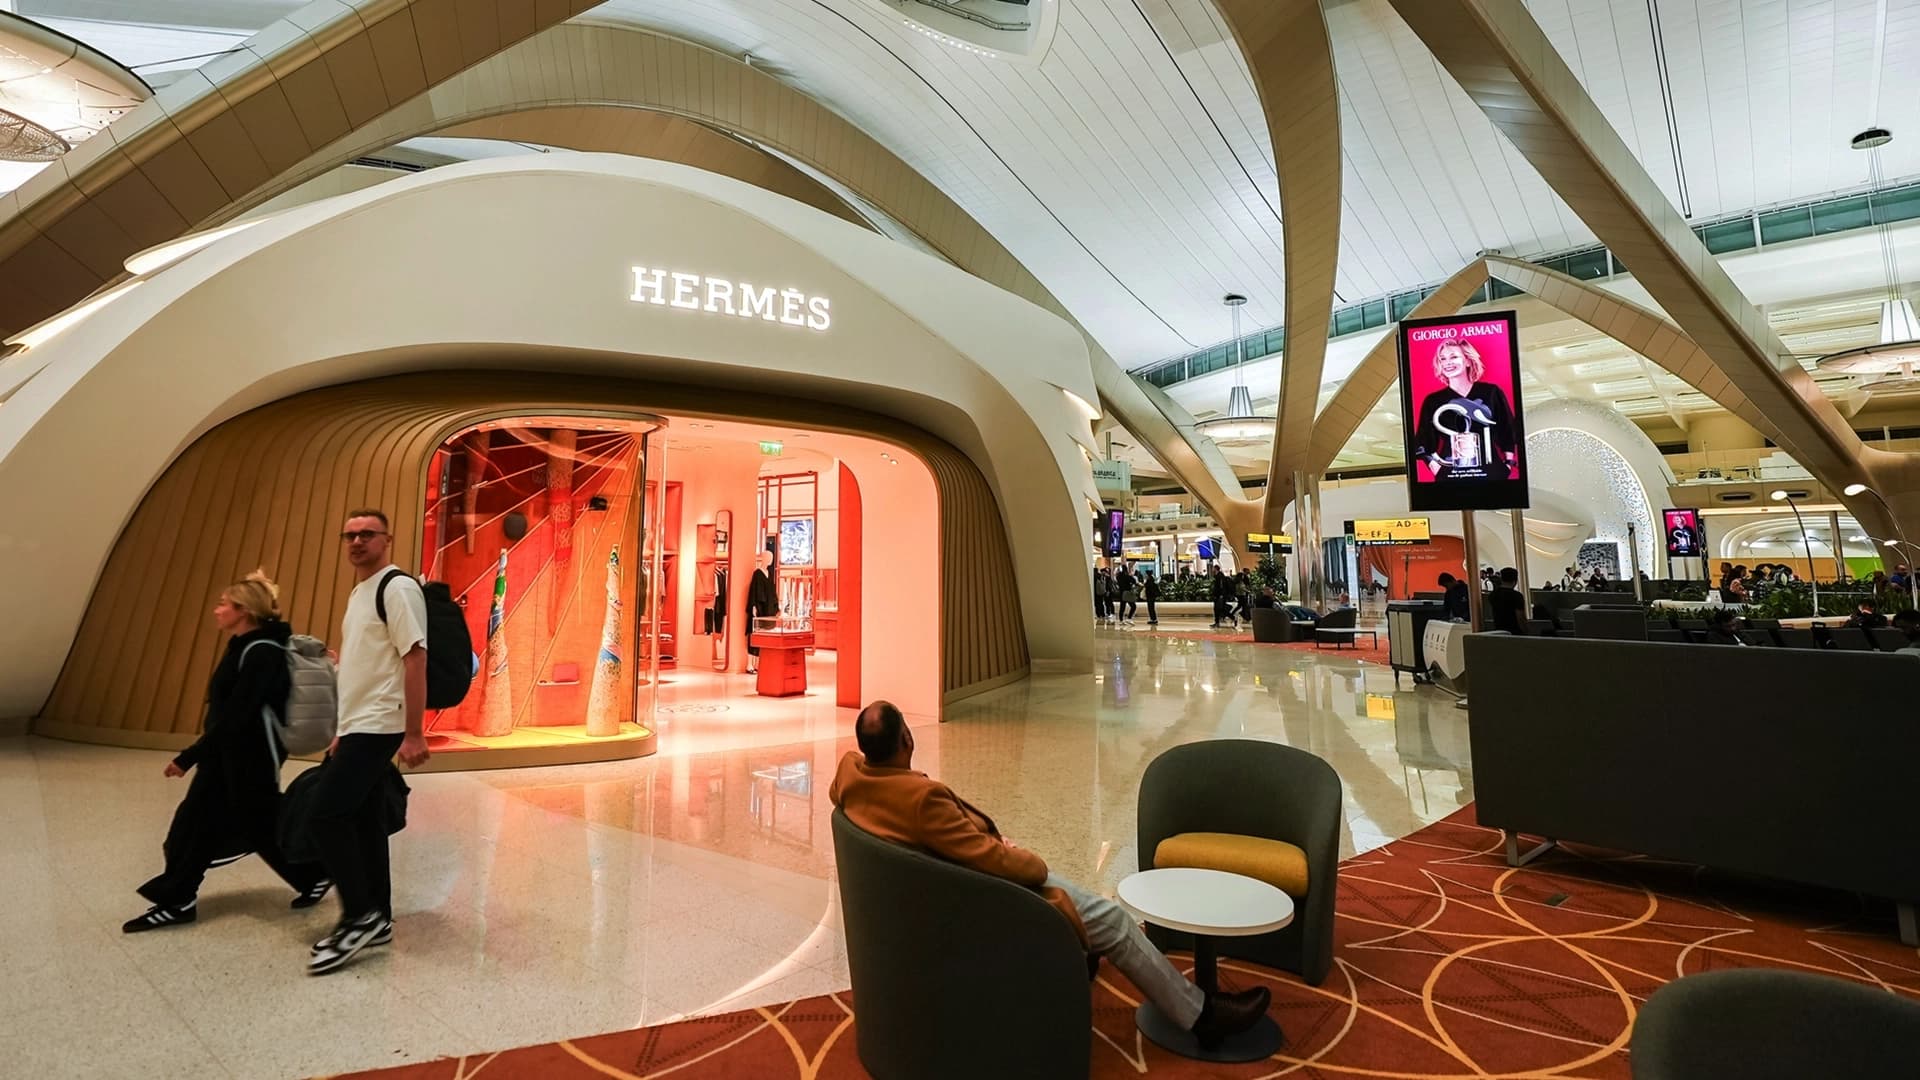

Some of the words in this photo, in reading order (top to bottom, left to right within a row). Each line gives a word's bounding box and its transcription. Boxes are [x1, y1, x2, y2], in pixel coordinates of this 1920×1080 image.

[630, 266, 831, 331] HERMÈS
[1413, 328, 1457, 341] GIORGIO
[1461, 324, 1502, 337] ARMANI
